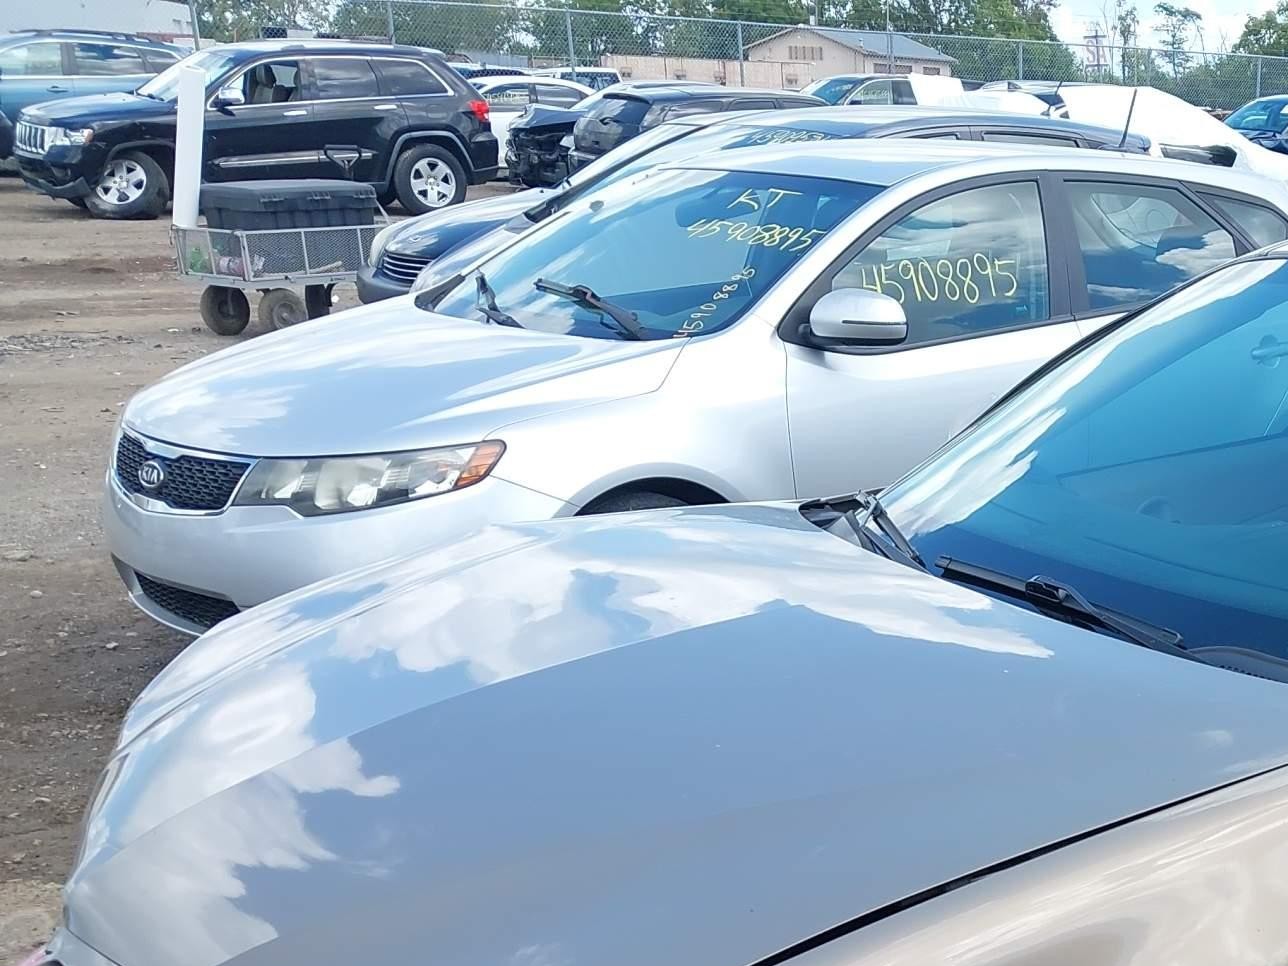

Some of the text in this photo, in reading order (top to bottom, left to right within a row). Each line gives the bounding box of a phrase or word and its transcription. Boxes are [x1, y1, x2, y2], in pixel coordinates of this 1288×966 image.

[727, 188, 803, 210] KT
[687, 218, 828, 251] 45908895
[861, 252, 1018, 304] 45908895
[673, 265, 756, 338] 45908895
[142, 465, 158, 484] KIA
